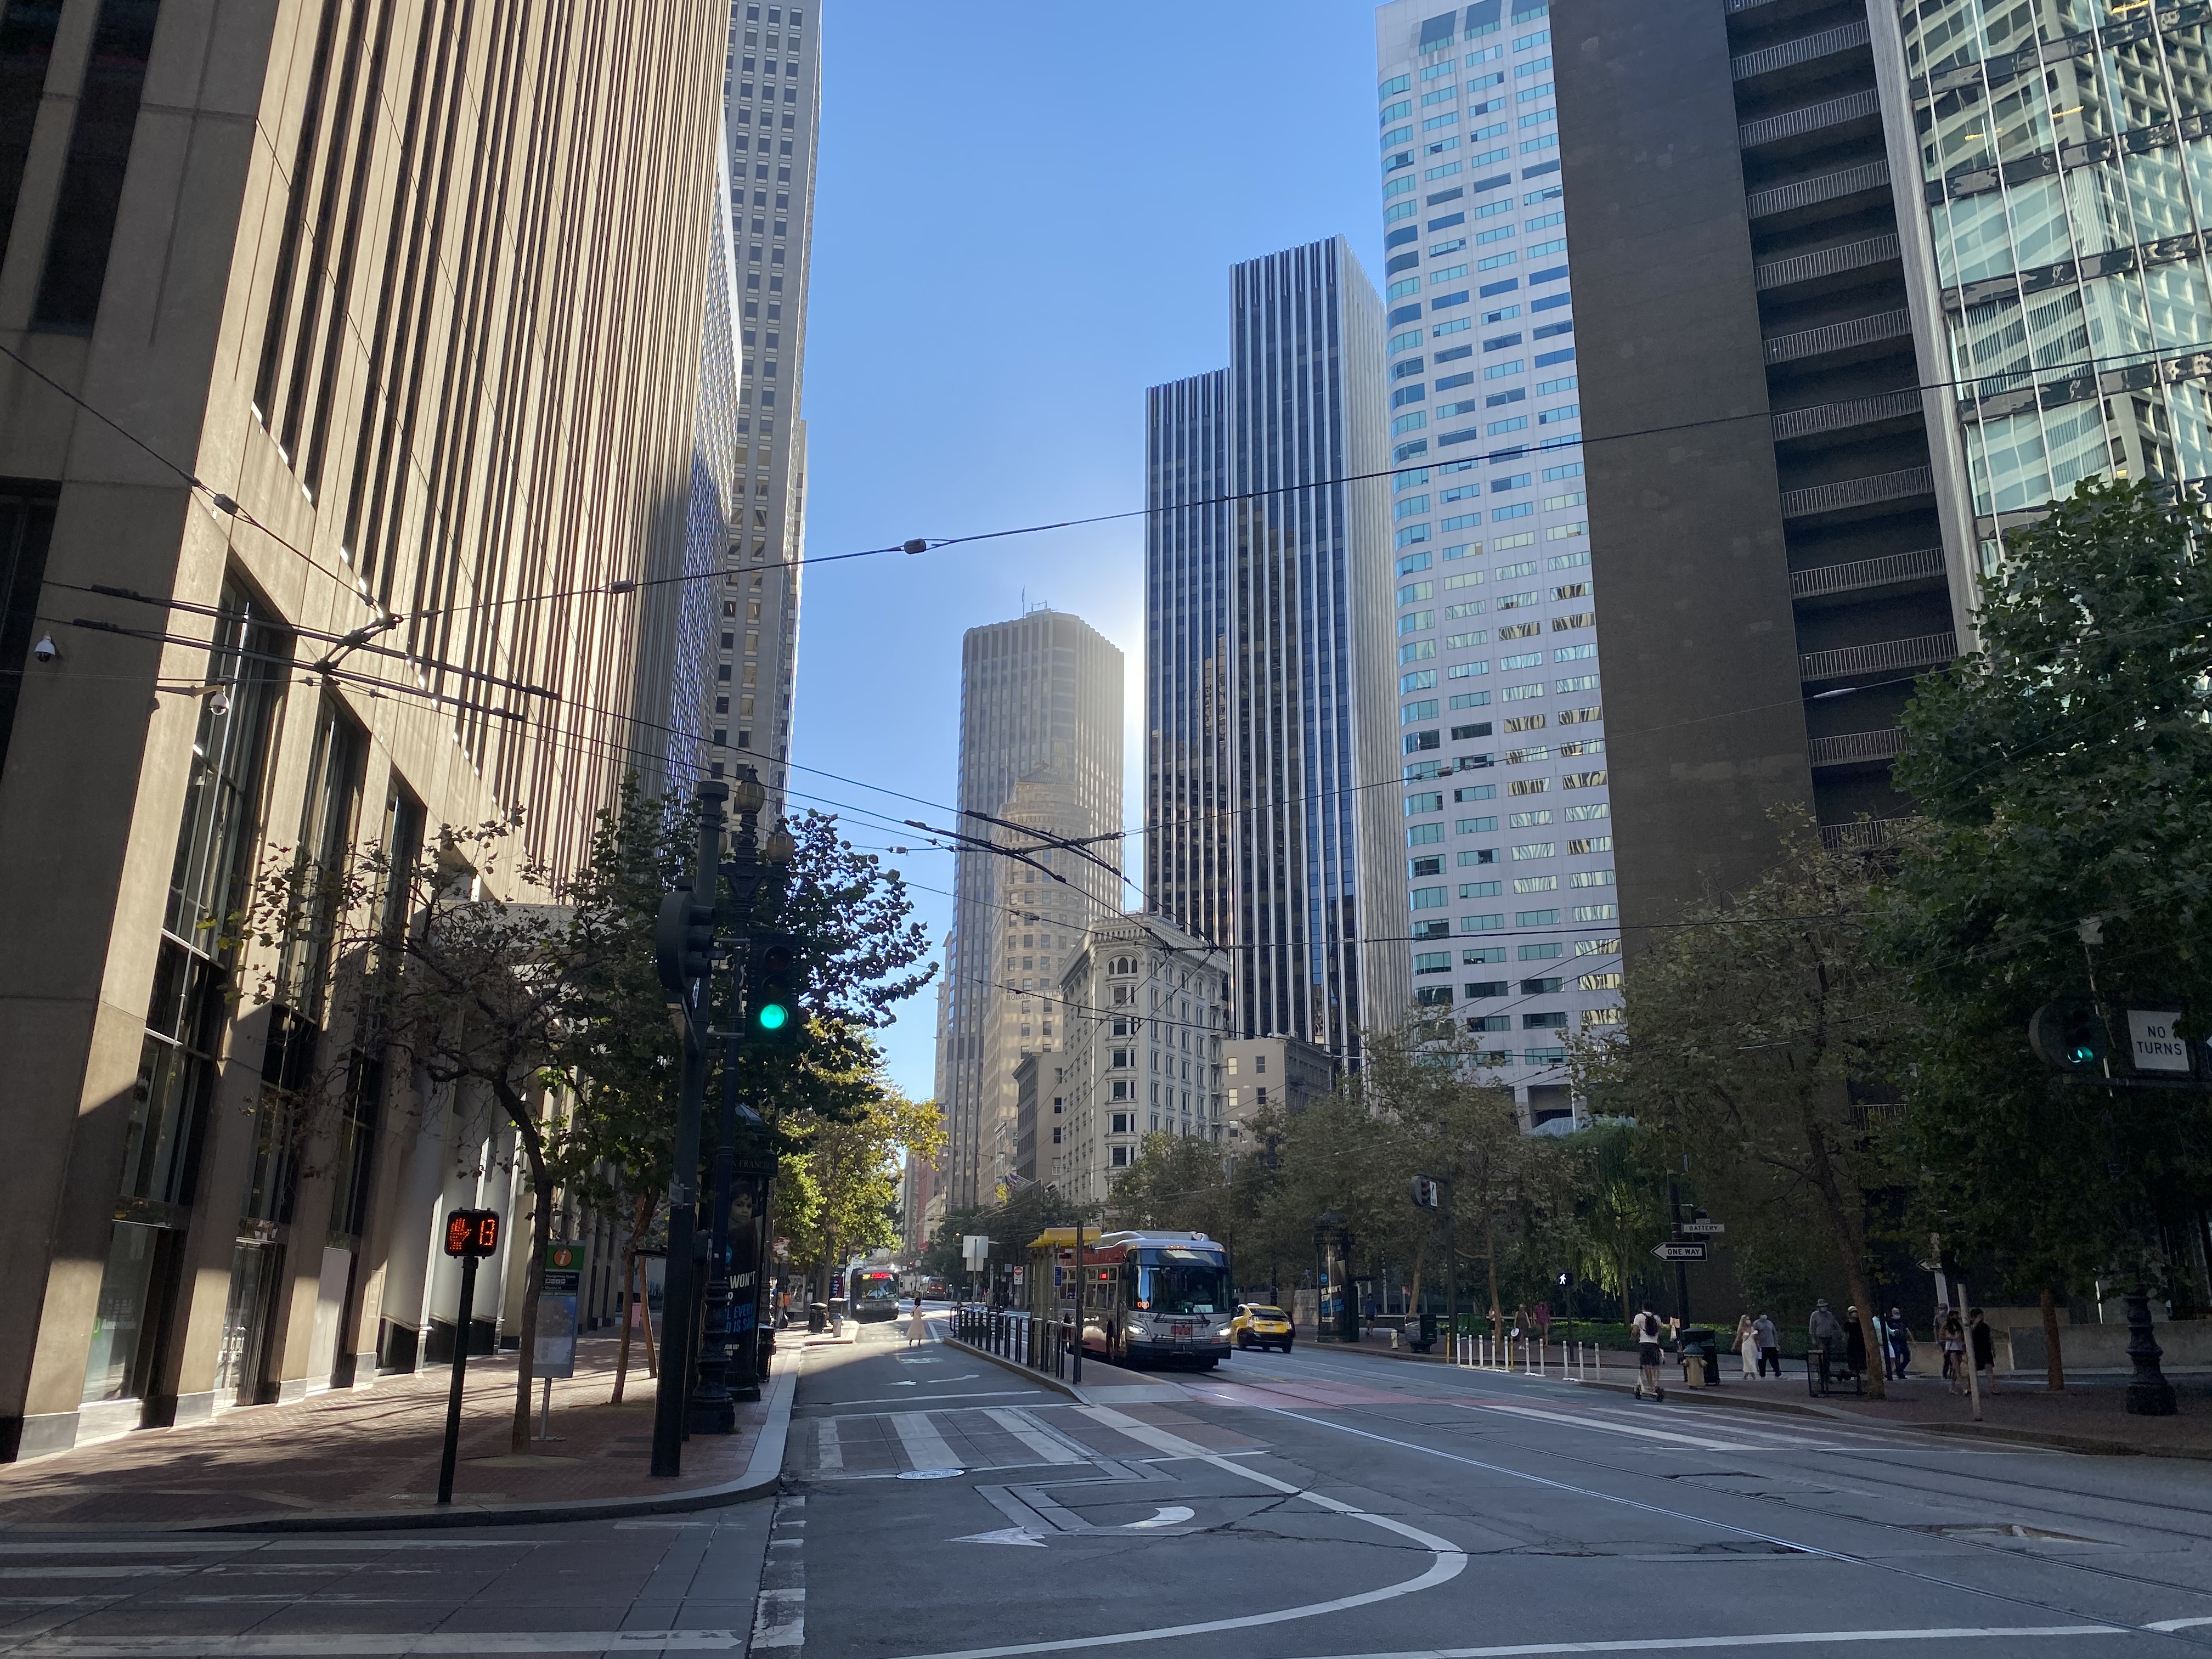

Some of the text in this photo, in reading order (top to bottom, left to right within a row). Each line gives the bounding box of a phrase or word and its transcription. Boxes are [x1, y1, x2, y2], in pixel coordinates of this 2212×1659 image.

[1006, 992, 1035, 1001] HOBART
[2147, 1025, 2165, 1038] NO
[2136, 1041, 2182, 1056] TURNS
[479, 1219, 495, 1246] 13
[730, 1271, 756, 1289] WON'T
[733, 1303, 754, 1318] EVERY
[733, 1319, 741, 1333] IS
